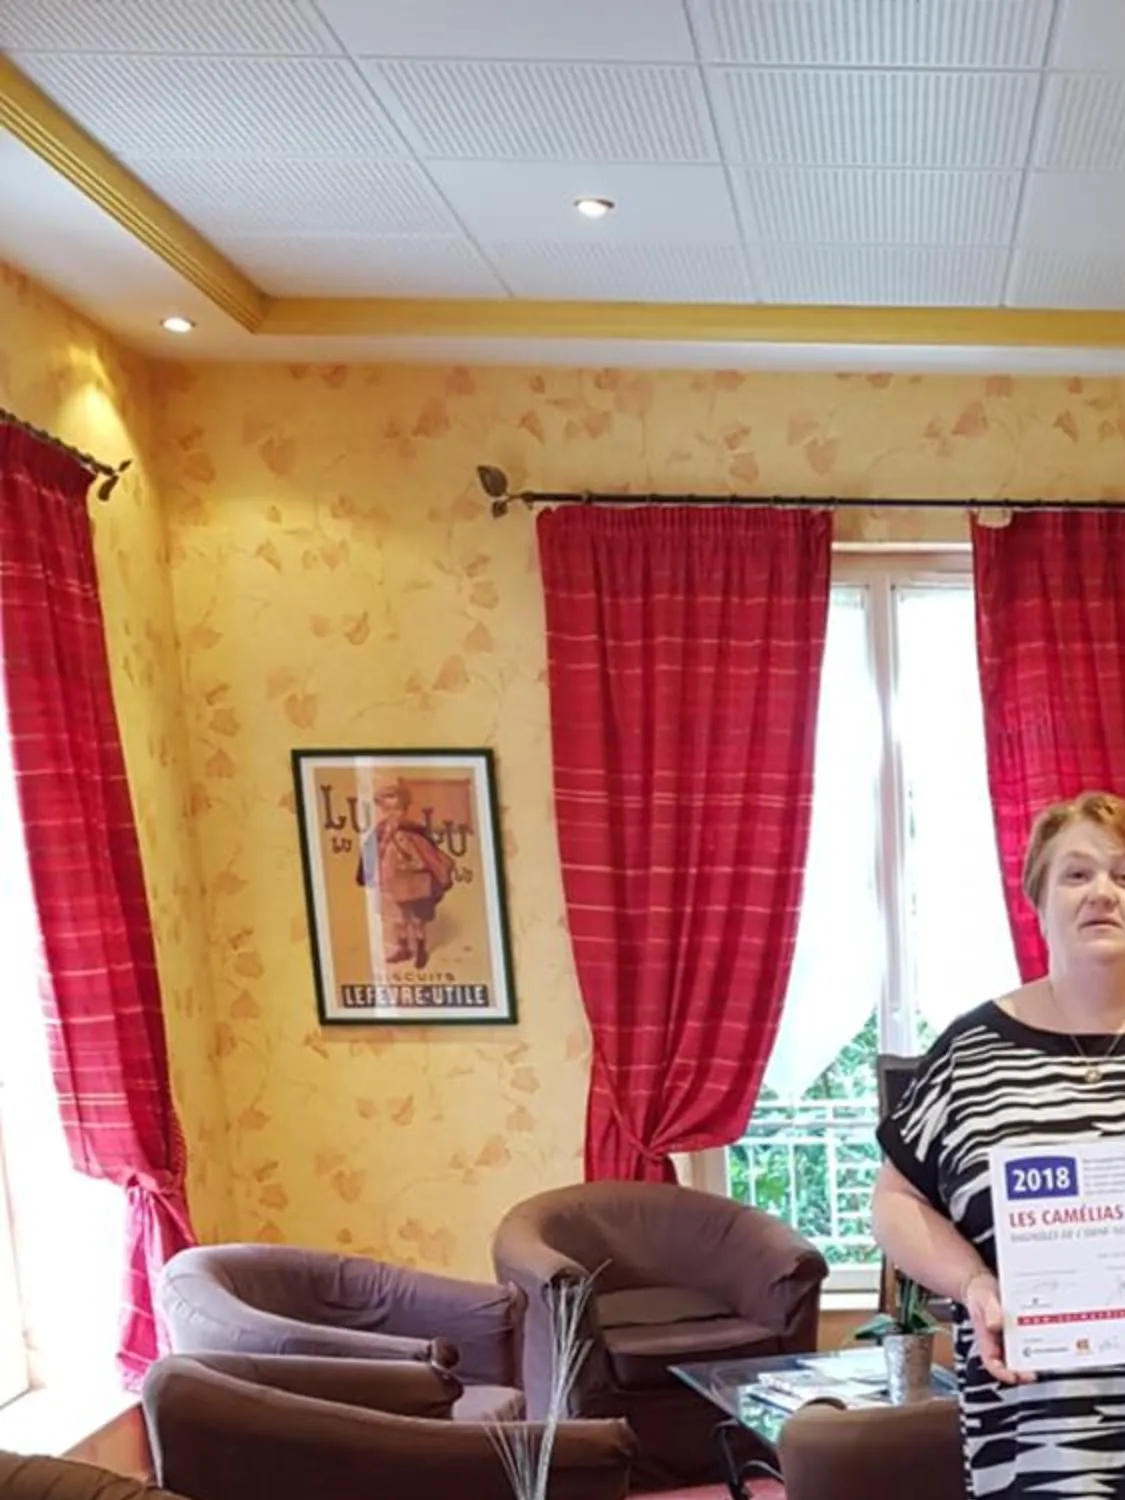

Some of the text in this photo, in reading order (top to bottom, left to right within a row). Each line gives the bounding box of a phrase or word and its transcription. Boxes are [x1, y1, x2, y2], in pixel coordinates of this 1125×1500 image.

[421, 807, 474, 857] LU
[1012, 1166, 1070, 1192] 2018
[1009, 1203, 1124, 1228] LES CAMÉLIAS
